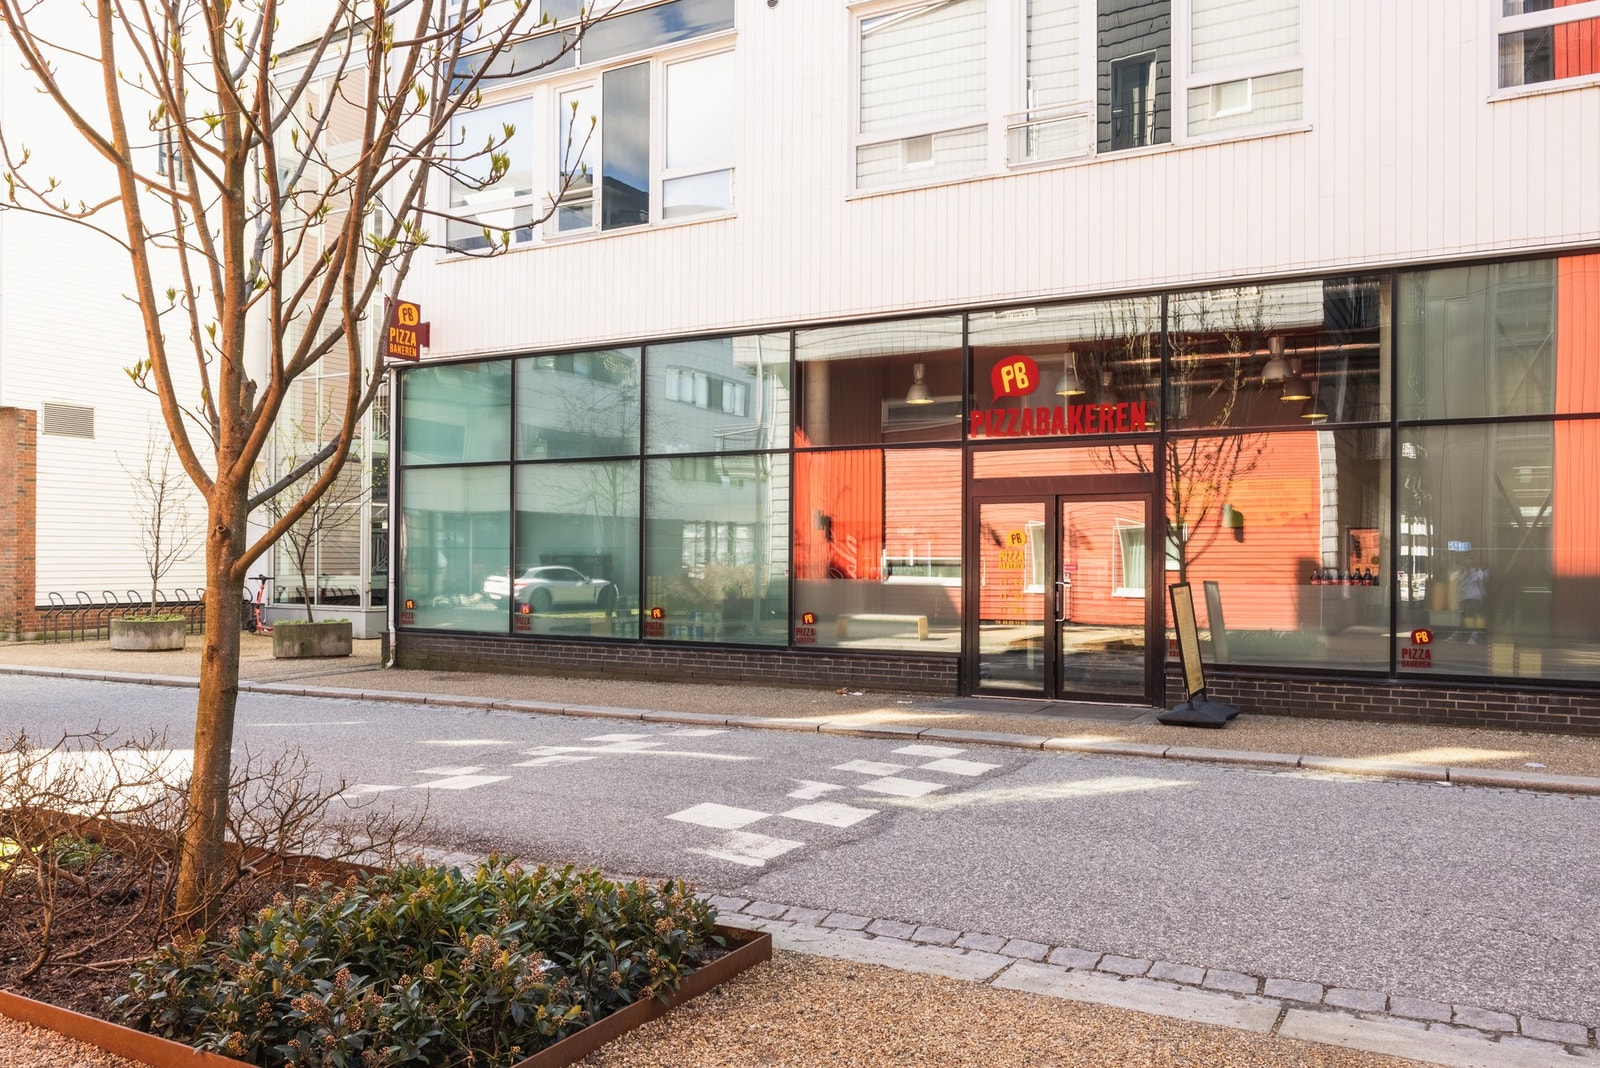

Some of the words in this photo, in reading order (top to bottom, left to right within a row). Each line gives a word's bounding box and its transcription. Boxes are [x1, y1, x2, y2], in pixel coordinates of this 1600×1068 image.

[402, 307, 414, 322] PB
[389, 327, 417, 347] PIZZA
[389, 343, 417, 357] BAKEREN
[1001, 361, 1030, 393] PB
[969, 401, 1147, 438] PIZZABAKEREN
[1011, 533, 1022, 544] PB
[998, 550, 1025, 562] PIZZA
[796, 628, 815, 637] PIZZA
[1415, 631, 1429, 643] PB
[1401, 648, 1431, 660] PIZZA
